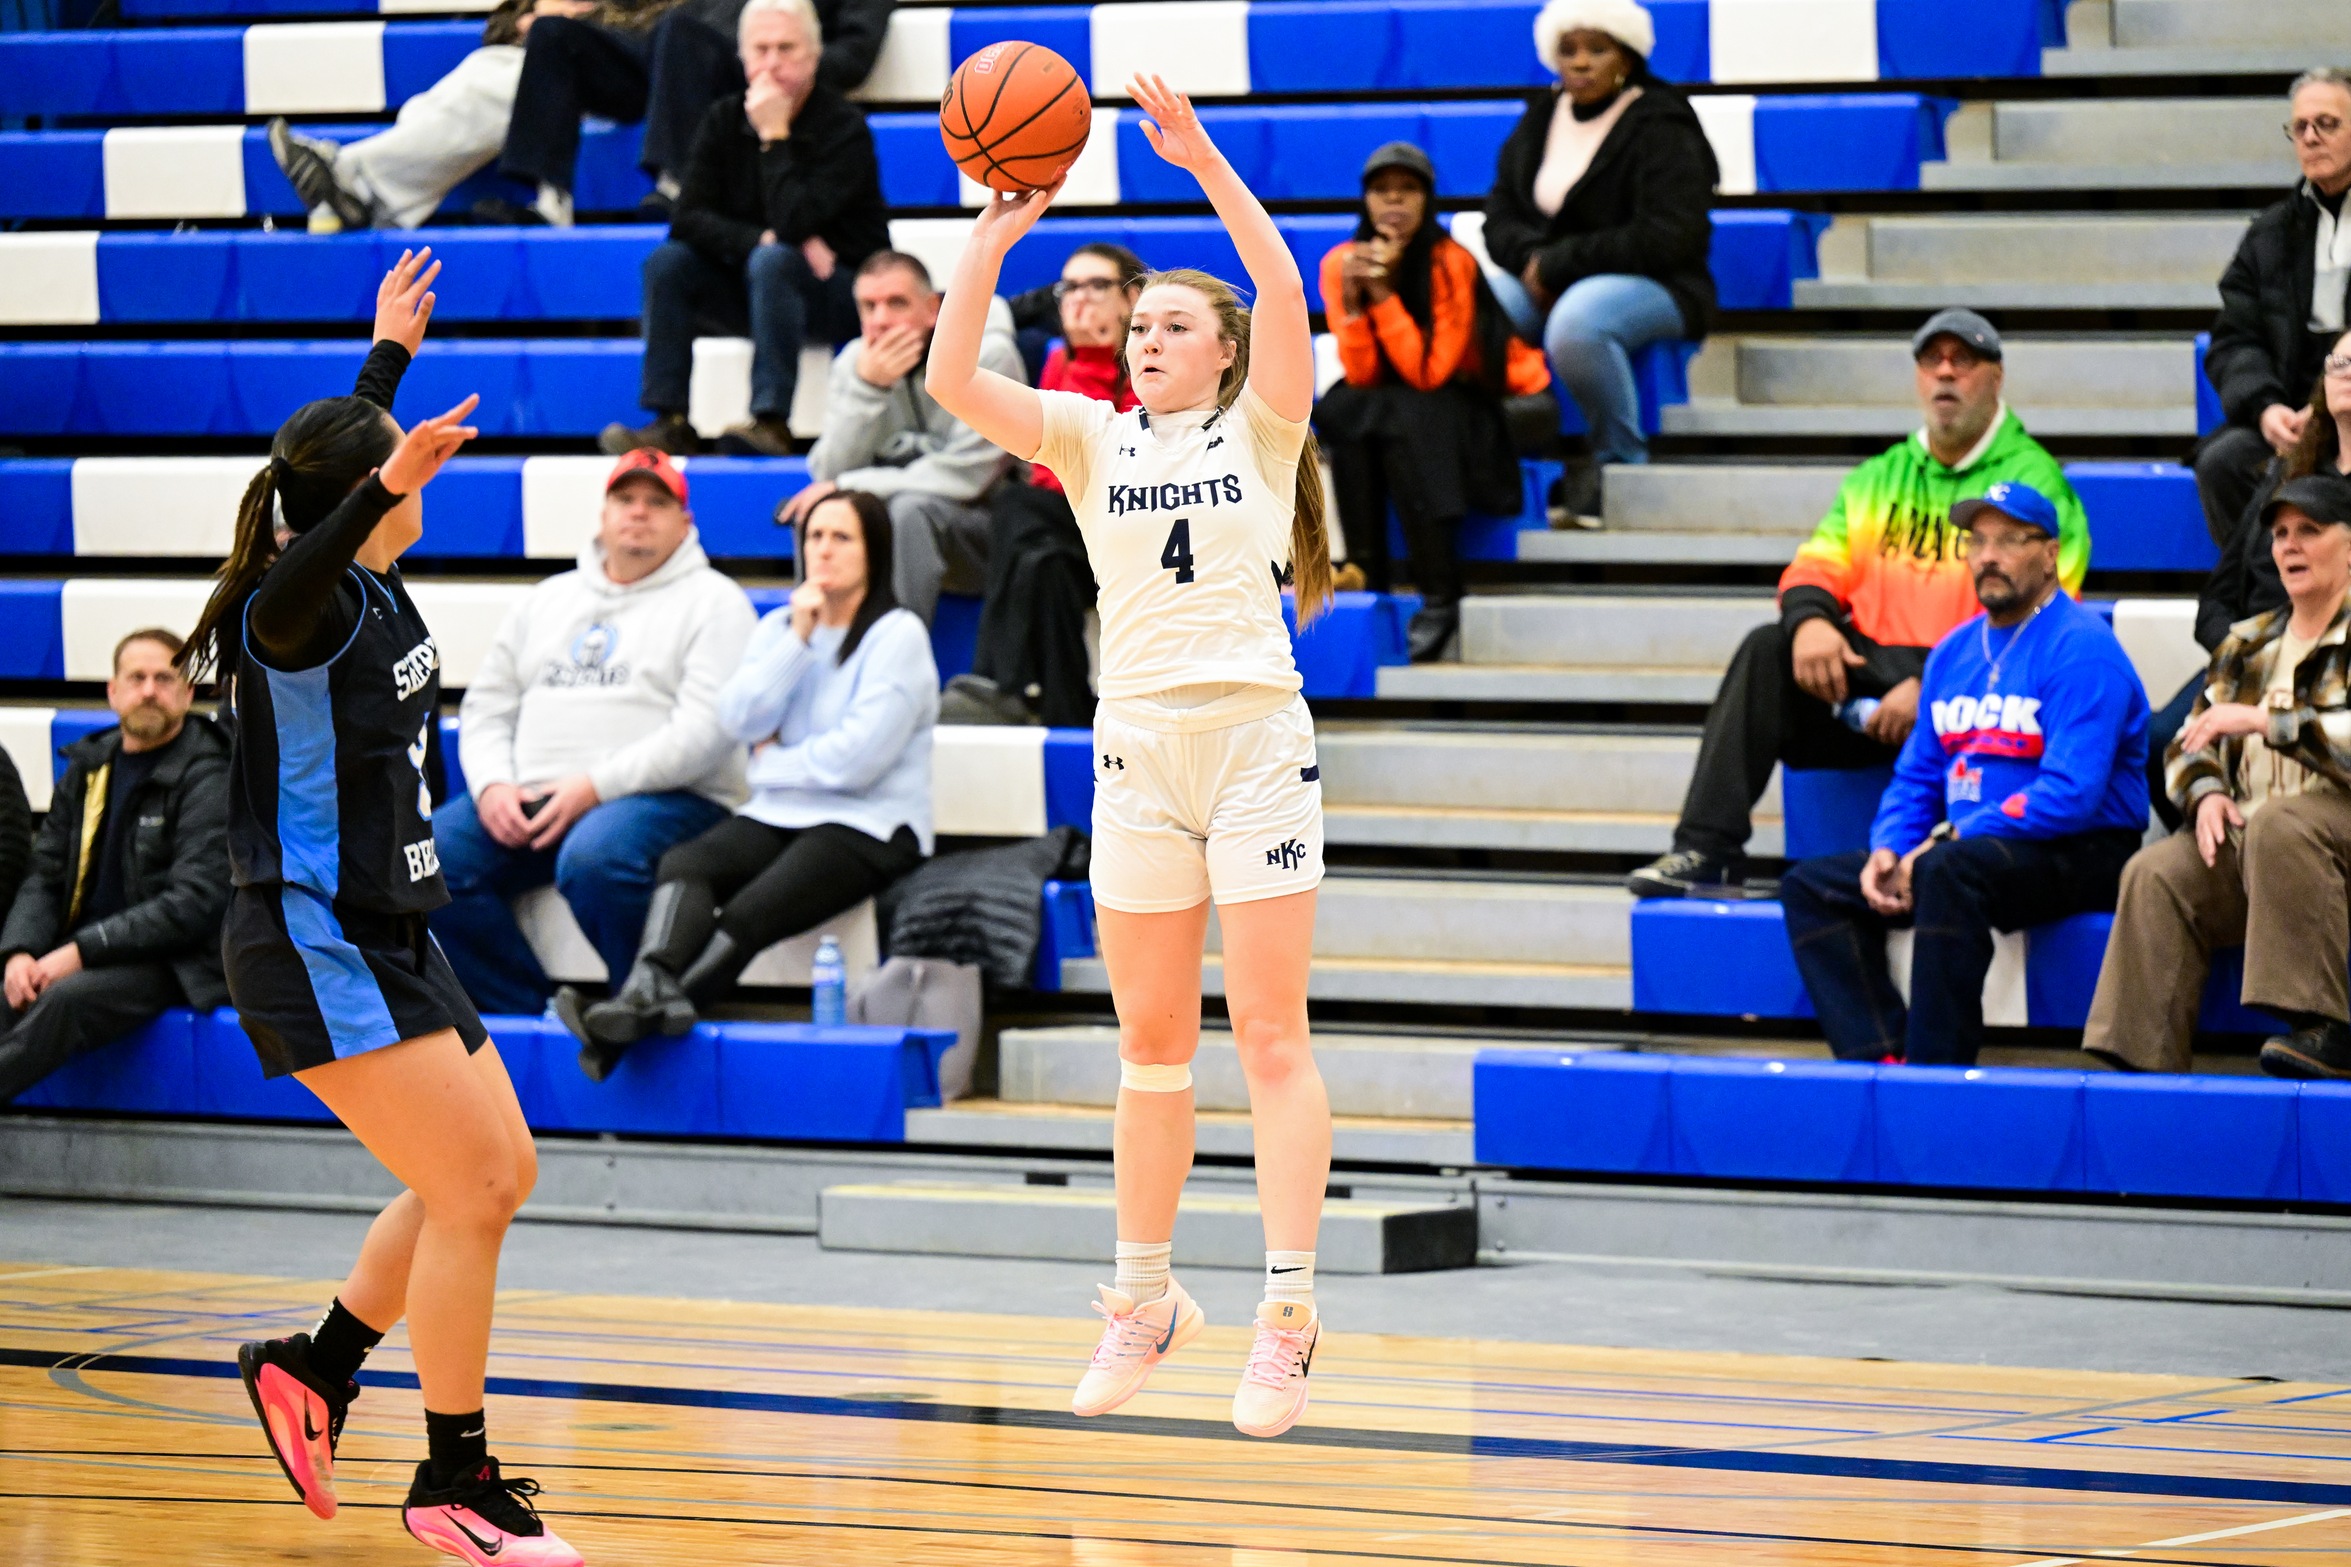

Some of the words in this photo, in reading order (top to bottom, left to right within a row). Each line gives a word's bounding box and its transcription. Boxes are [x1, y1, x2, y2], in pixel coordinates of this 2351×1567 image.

[1108, 473, 1243, 517] KNIGHTS
[1160, 518, 1195, 585] 4
[1265, 838, 1307, 872] NKC
